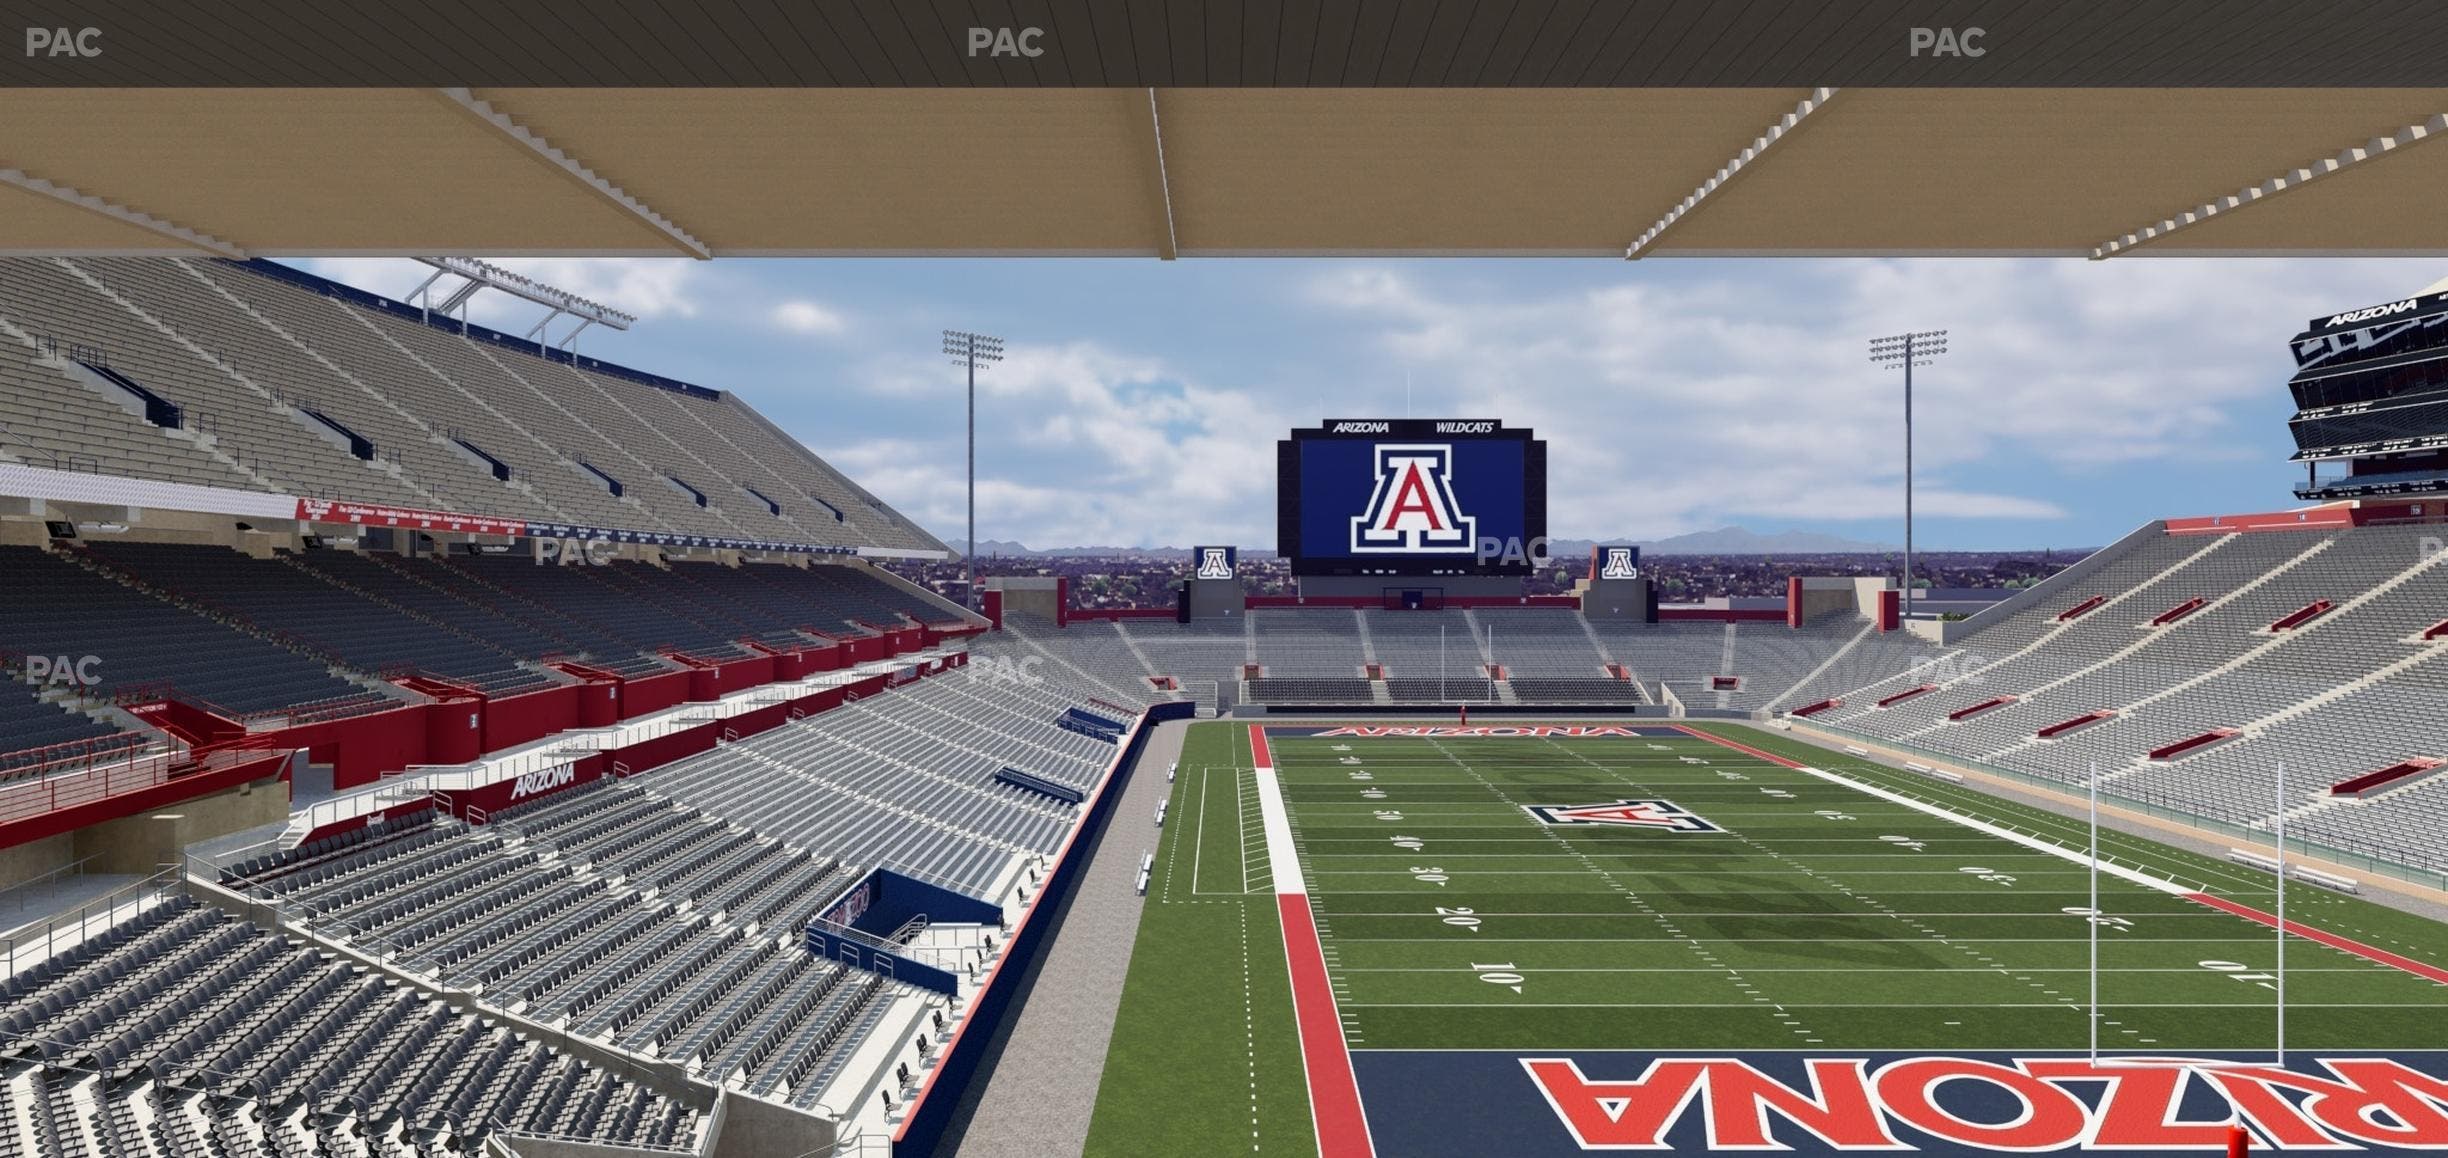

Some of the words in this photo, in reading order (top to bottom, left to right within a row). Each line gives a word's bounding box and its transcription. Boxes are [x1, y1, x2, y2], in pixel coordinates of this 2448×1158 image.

[2325, 298, 2417, 328] ARIZONA
[1333, 422, 1389, 433] ARIZONA
[1436, 422, 1494, 433] WILDCATS
[1198, 549, 1233, 580] A
[1602, 549, 1637, 580] A
[1311, 725, 1641, 737] ARIZONA
[510, 763, 574, 800] ARIZONA
[1410, 866, 1450, 882] 30
[1958, 866, 2017, 881] 30
[1435, 907, 1482, 926] 20
[1471, 961, 1525, 984] 10
[2198, 960, 2280, 982] 10
[1518, 1057, 2448, 1153] RIZONA
